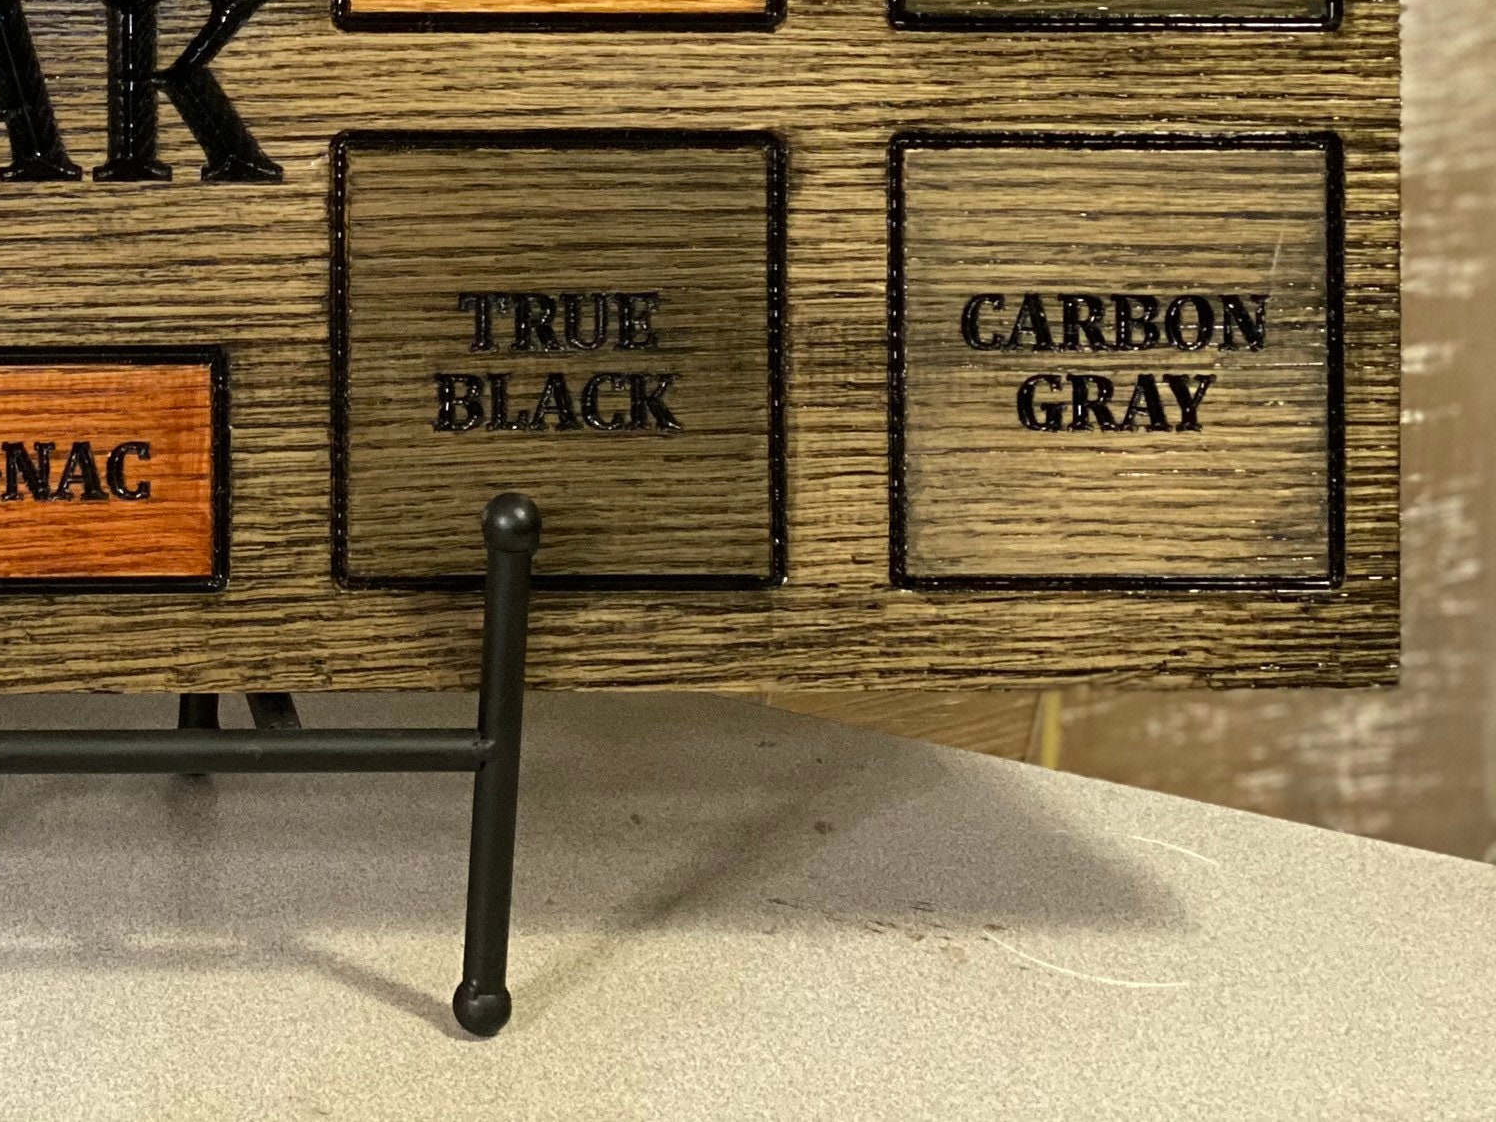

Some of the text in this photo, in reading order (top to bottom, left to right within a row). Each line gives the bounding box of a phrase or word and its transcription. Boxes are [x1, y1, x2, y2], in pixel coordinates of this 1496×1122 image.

[457, 291, 660, 353] TRUE
[959, 293, 1271, 354] CARBON
[433, 372, 682, 433] BLACK
[1016, 372, 1216, 433] GRAY
